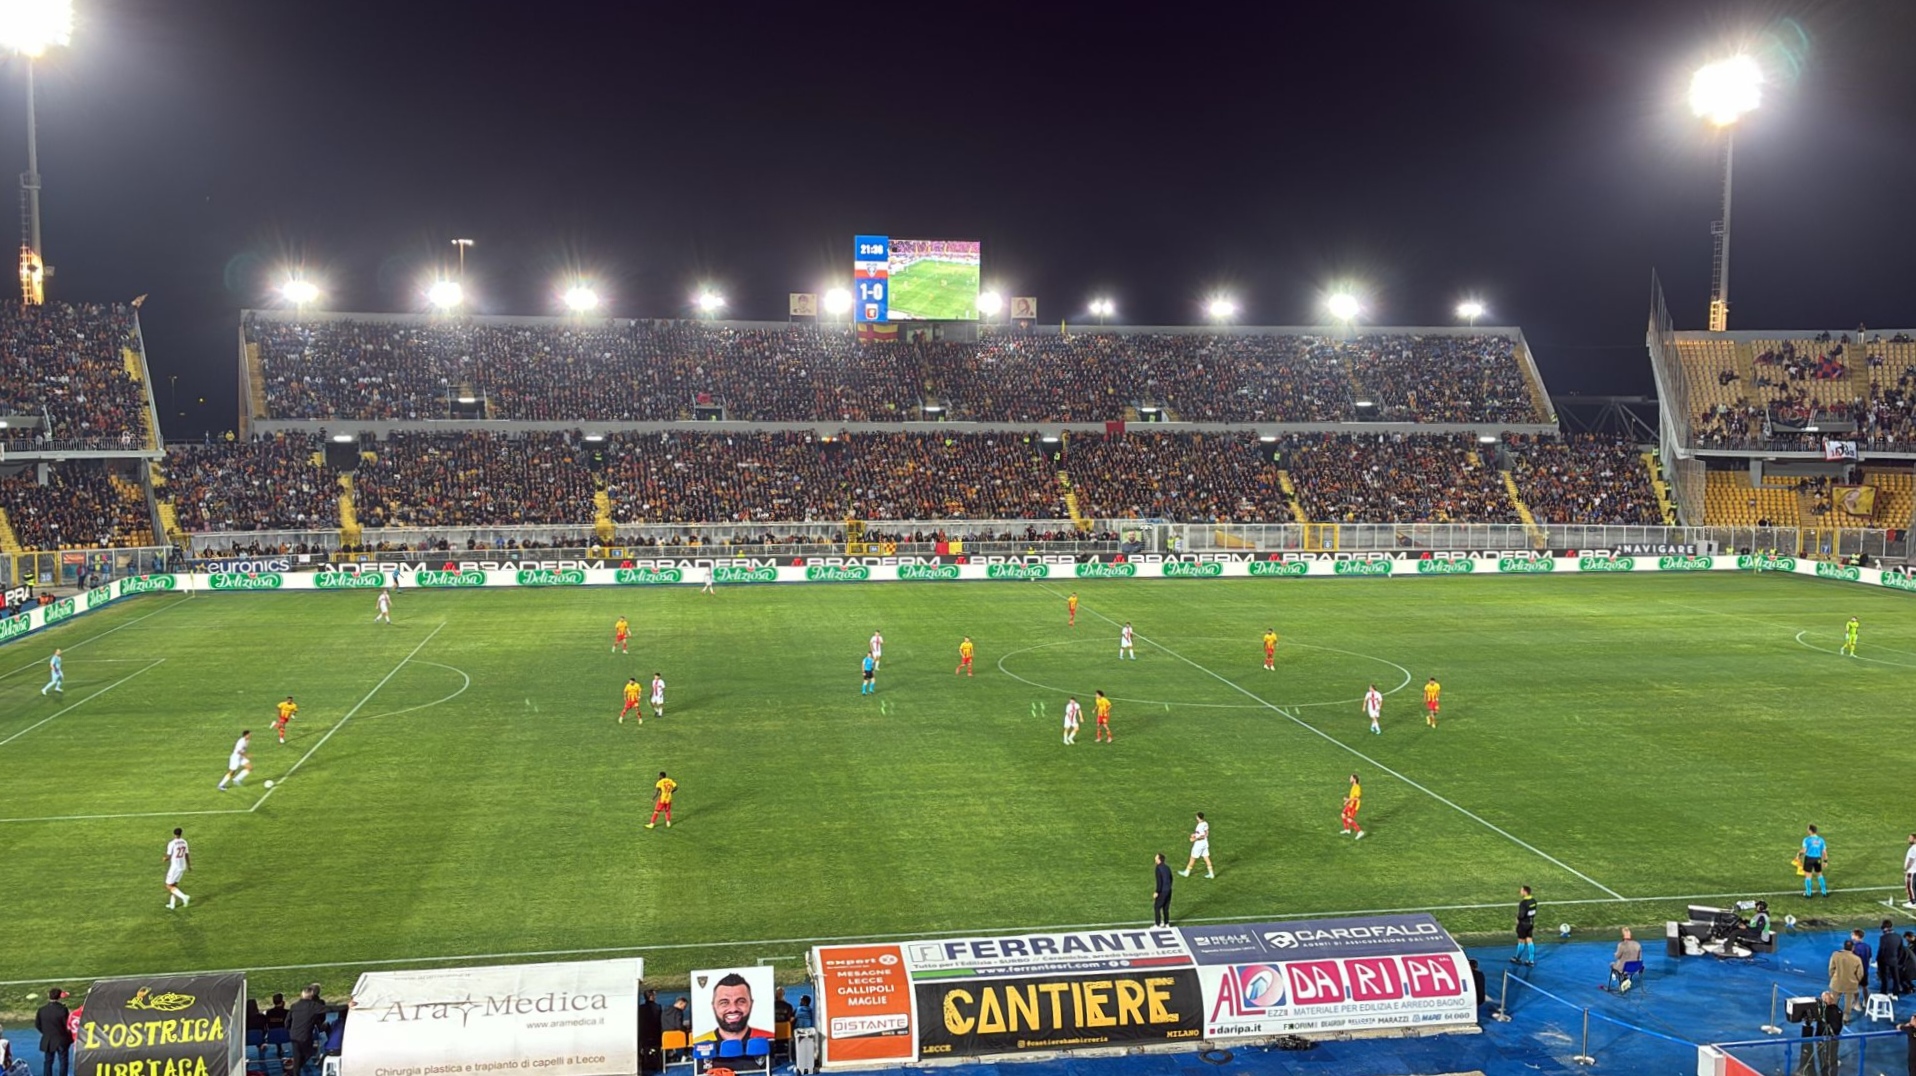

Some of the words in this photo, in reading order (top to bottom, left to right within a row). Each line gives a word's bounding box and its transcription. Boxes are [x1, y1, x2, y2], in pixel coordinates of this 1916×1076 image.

[1624, 545, 1694, 553] NAVIGARE
[208, 560, 290, 573] euronics
[215, 572, 273, 587] Deliziosa
[944, 931, 1180, 960] FERRANTE
[837, 969, 892, 977] MESAGNE
[848, 976, 884, 985] LECCE
[838, 984, 894, 995] GALLIPOLI
[377, 1001, 450, 1022] Ara
[482, 992, 608, 1017] Medica
[848, 996, 888, 1006] MAGLIE
[943, 978, 1179, 1035] CANTIERE
[1294, 1005, 1339, 1016] MATERIALE
[1341, 1004, 1358, 1013] PER
[1360, 1002, 1391, 1012] EDILIZIA
[1401, 1000, 1435, 1009] ARREDO
[1437, 998, 1465, 1007] BAGNO
[526, 1017, 605, 1029] www.aramedica.it
[834, 1018, 906, 1031] DISTANTE
[1378, 1016, 1409, 1024] MARAZZI
[84, 1016, 224, 1049] L'OSTRICA
[1167, 1029, 1200, 1038] MILANO
[1217, 1023, 1261, 1035] daripa.it
[922, 1045, 952, 1054] LECCE
[424, 1064, 462, 1075] plastica
[475, 1060, 518, 1072] trapianto
[521, 1059, 530, 1068] di
[532, 1056, 564, 1068] capelli
[576, 1055, 605, 1065] Lecce
